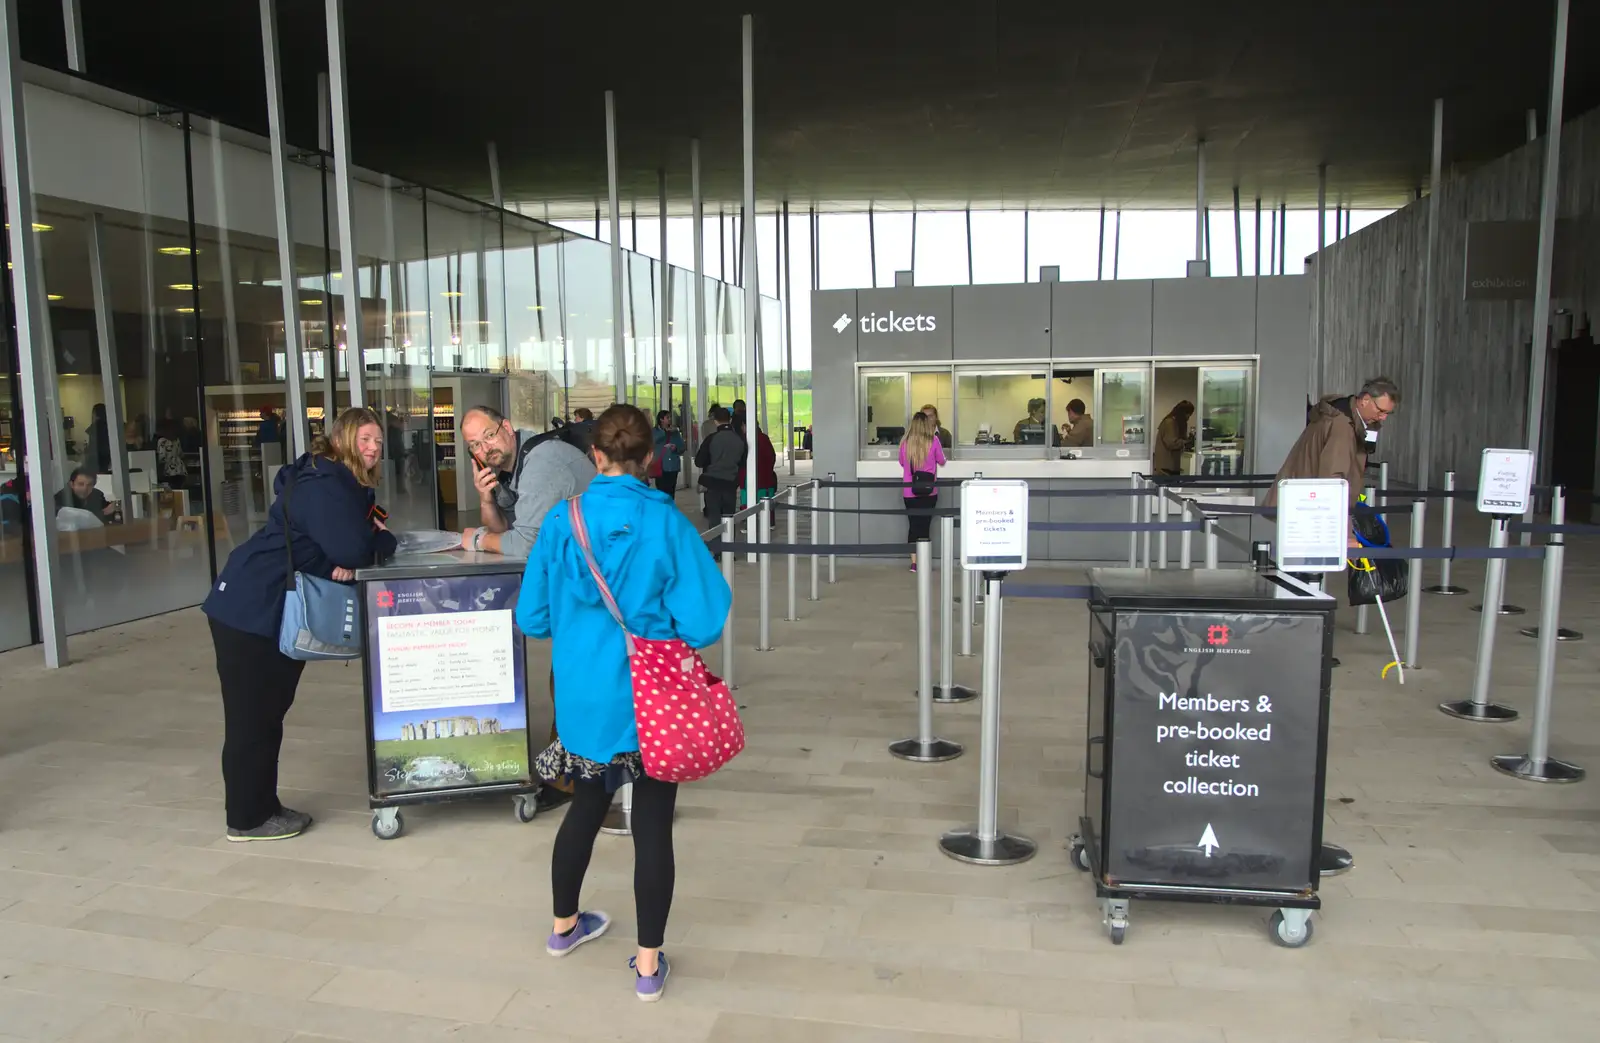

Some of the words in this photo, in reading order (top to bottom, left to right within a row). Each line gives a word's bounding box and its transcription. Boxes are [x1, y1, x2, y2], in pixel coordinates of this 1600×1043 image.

[1472, 278, 1529, 288] exhibition
[859, 310, 937, 333] tickets
[423, 619, 451, 628] MEMBER
[453, 618, 477, 626] TODAY
[472, 625, 501, 633] MONEY
[1158, 692, 1249, 712] Members
[1256, 695, 1273, 713] &
[1156, 721, 1272, 743] pre-booked
[1184, 750, 1241, 768] ticket
[384, 768, 411, 785] Step
[1162, 776, 1259, 797] collection
